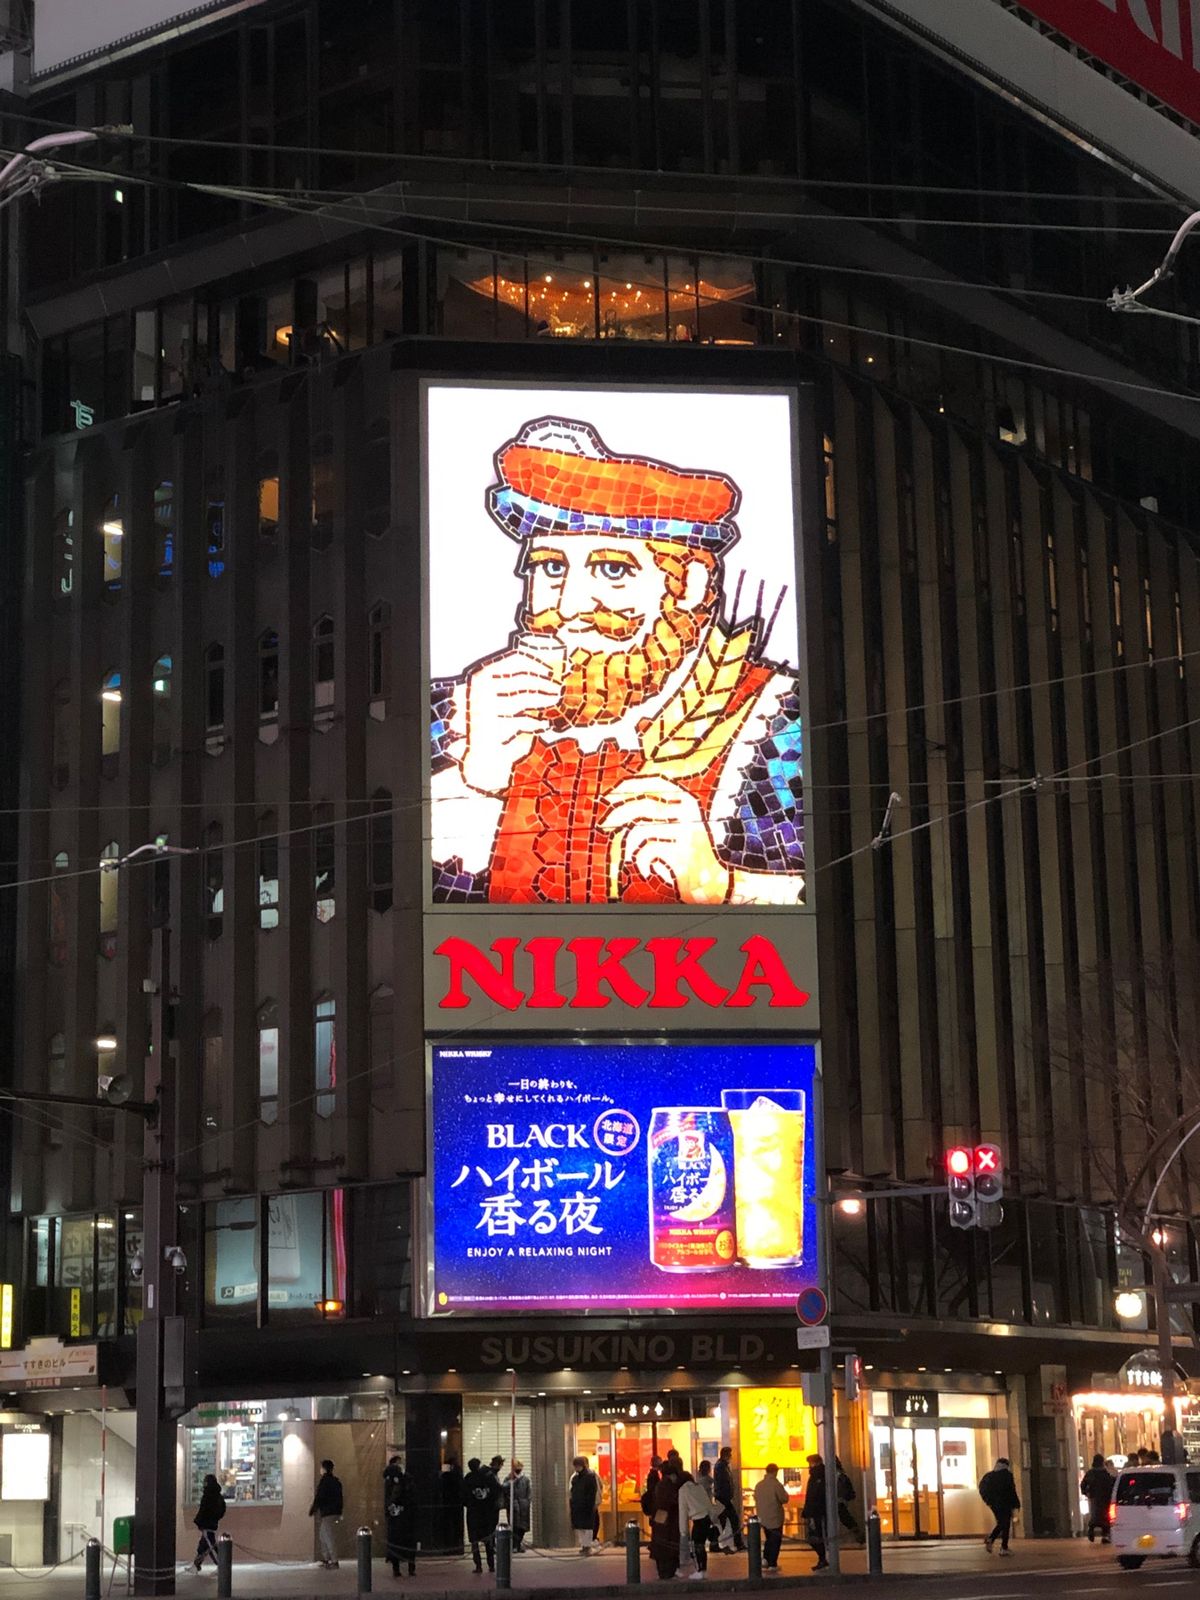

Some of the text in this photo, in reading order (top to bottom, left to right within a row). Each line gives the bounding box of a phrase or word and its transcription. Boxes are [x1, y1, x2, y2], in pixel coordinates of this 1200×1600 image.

[433, 934, 810, 1011] NIKKA
[486, 1124, 590, 1148] BLACK
[602, 1119, 634, 1135] 北海道
[450, 1157, 626, 1192] ハイボール
[475, 1191, 604, 1237] 香る夜
[467, 1246, 613, 1258] ENJOY A RELAXING NIGHT
[480, 1335, 675, 1365] SUSUKINO
[691, 1334, 774, 1362] BLD.
